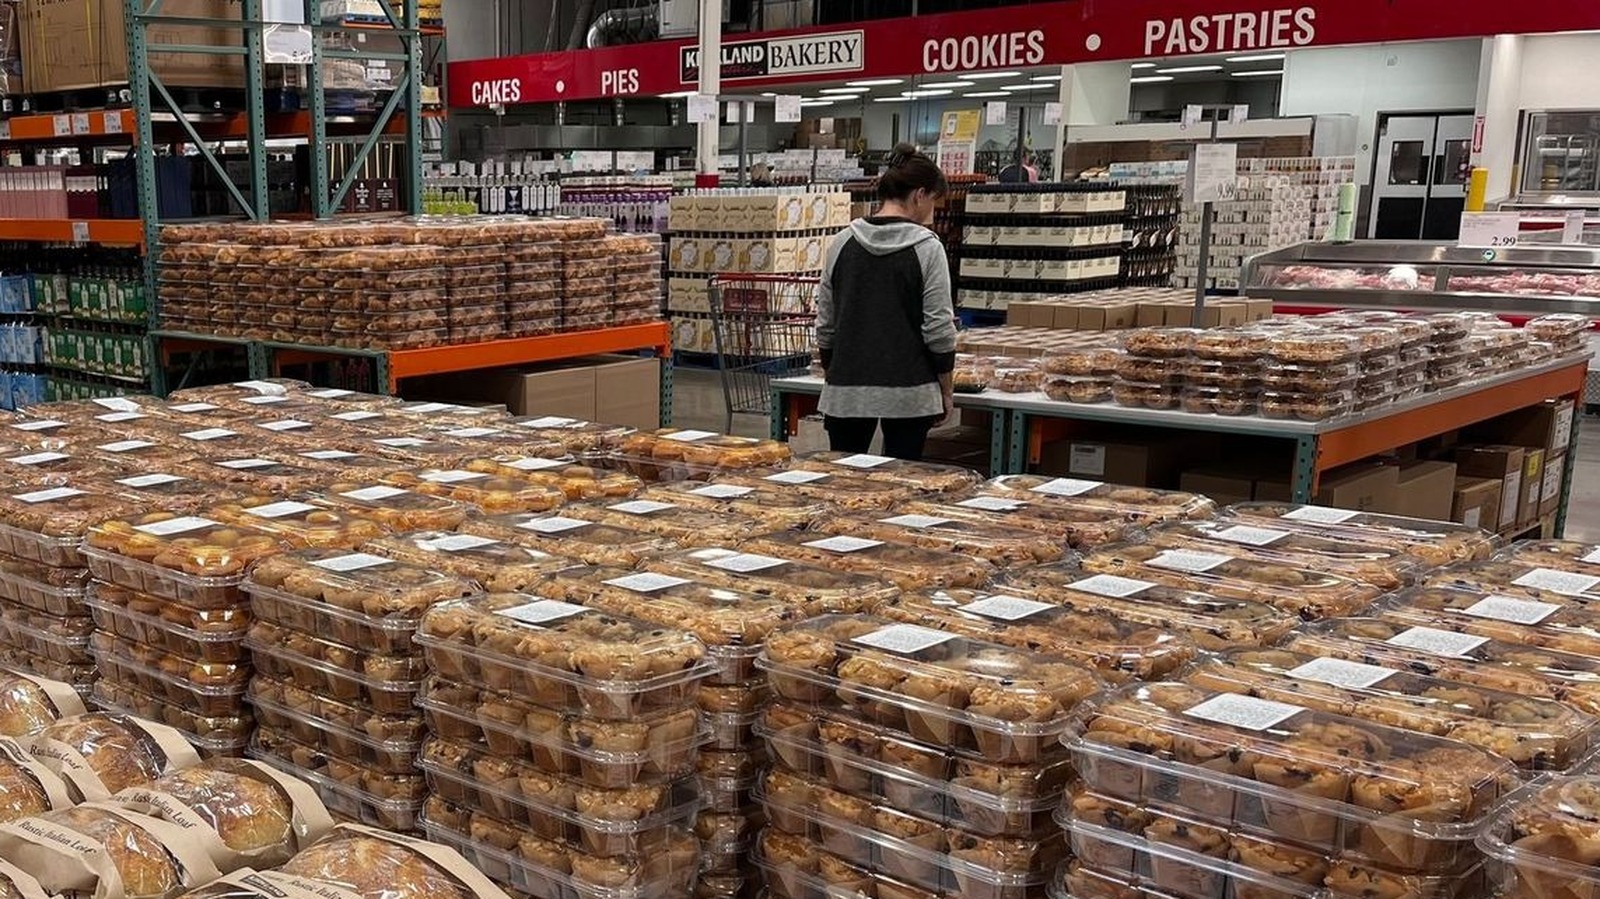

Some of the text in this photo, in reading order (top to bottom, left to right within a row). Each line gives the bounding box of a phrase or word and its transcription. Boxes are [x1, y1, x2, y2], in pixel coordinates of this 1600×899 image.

[1144, 7, 1316, 55] PASTRIES
[770, 38, 859, 69] BAKERY
[923, 29, 1045, 72] COOKIES
[471, 78, 522, 105] CAKES
[601, 68, 640, 96] PIES
[1217, 183, 1236, 198] 9.99
[1491, 236, 1516, 246] 2.99
[172, 811, 198, 829] Loaf
[18, 820, 98, 854] Rustic Italian Loaf
